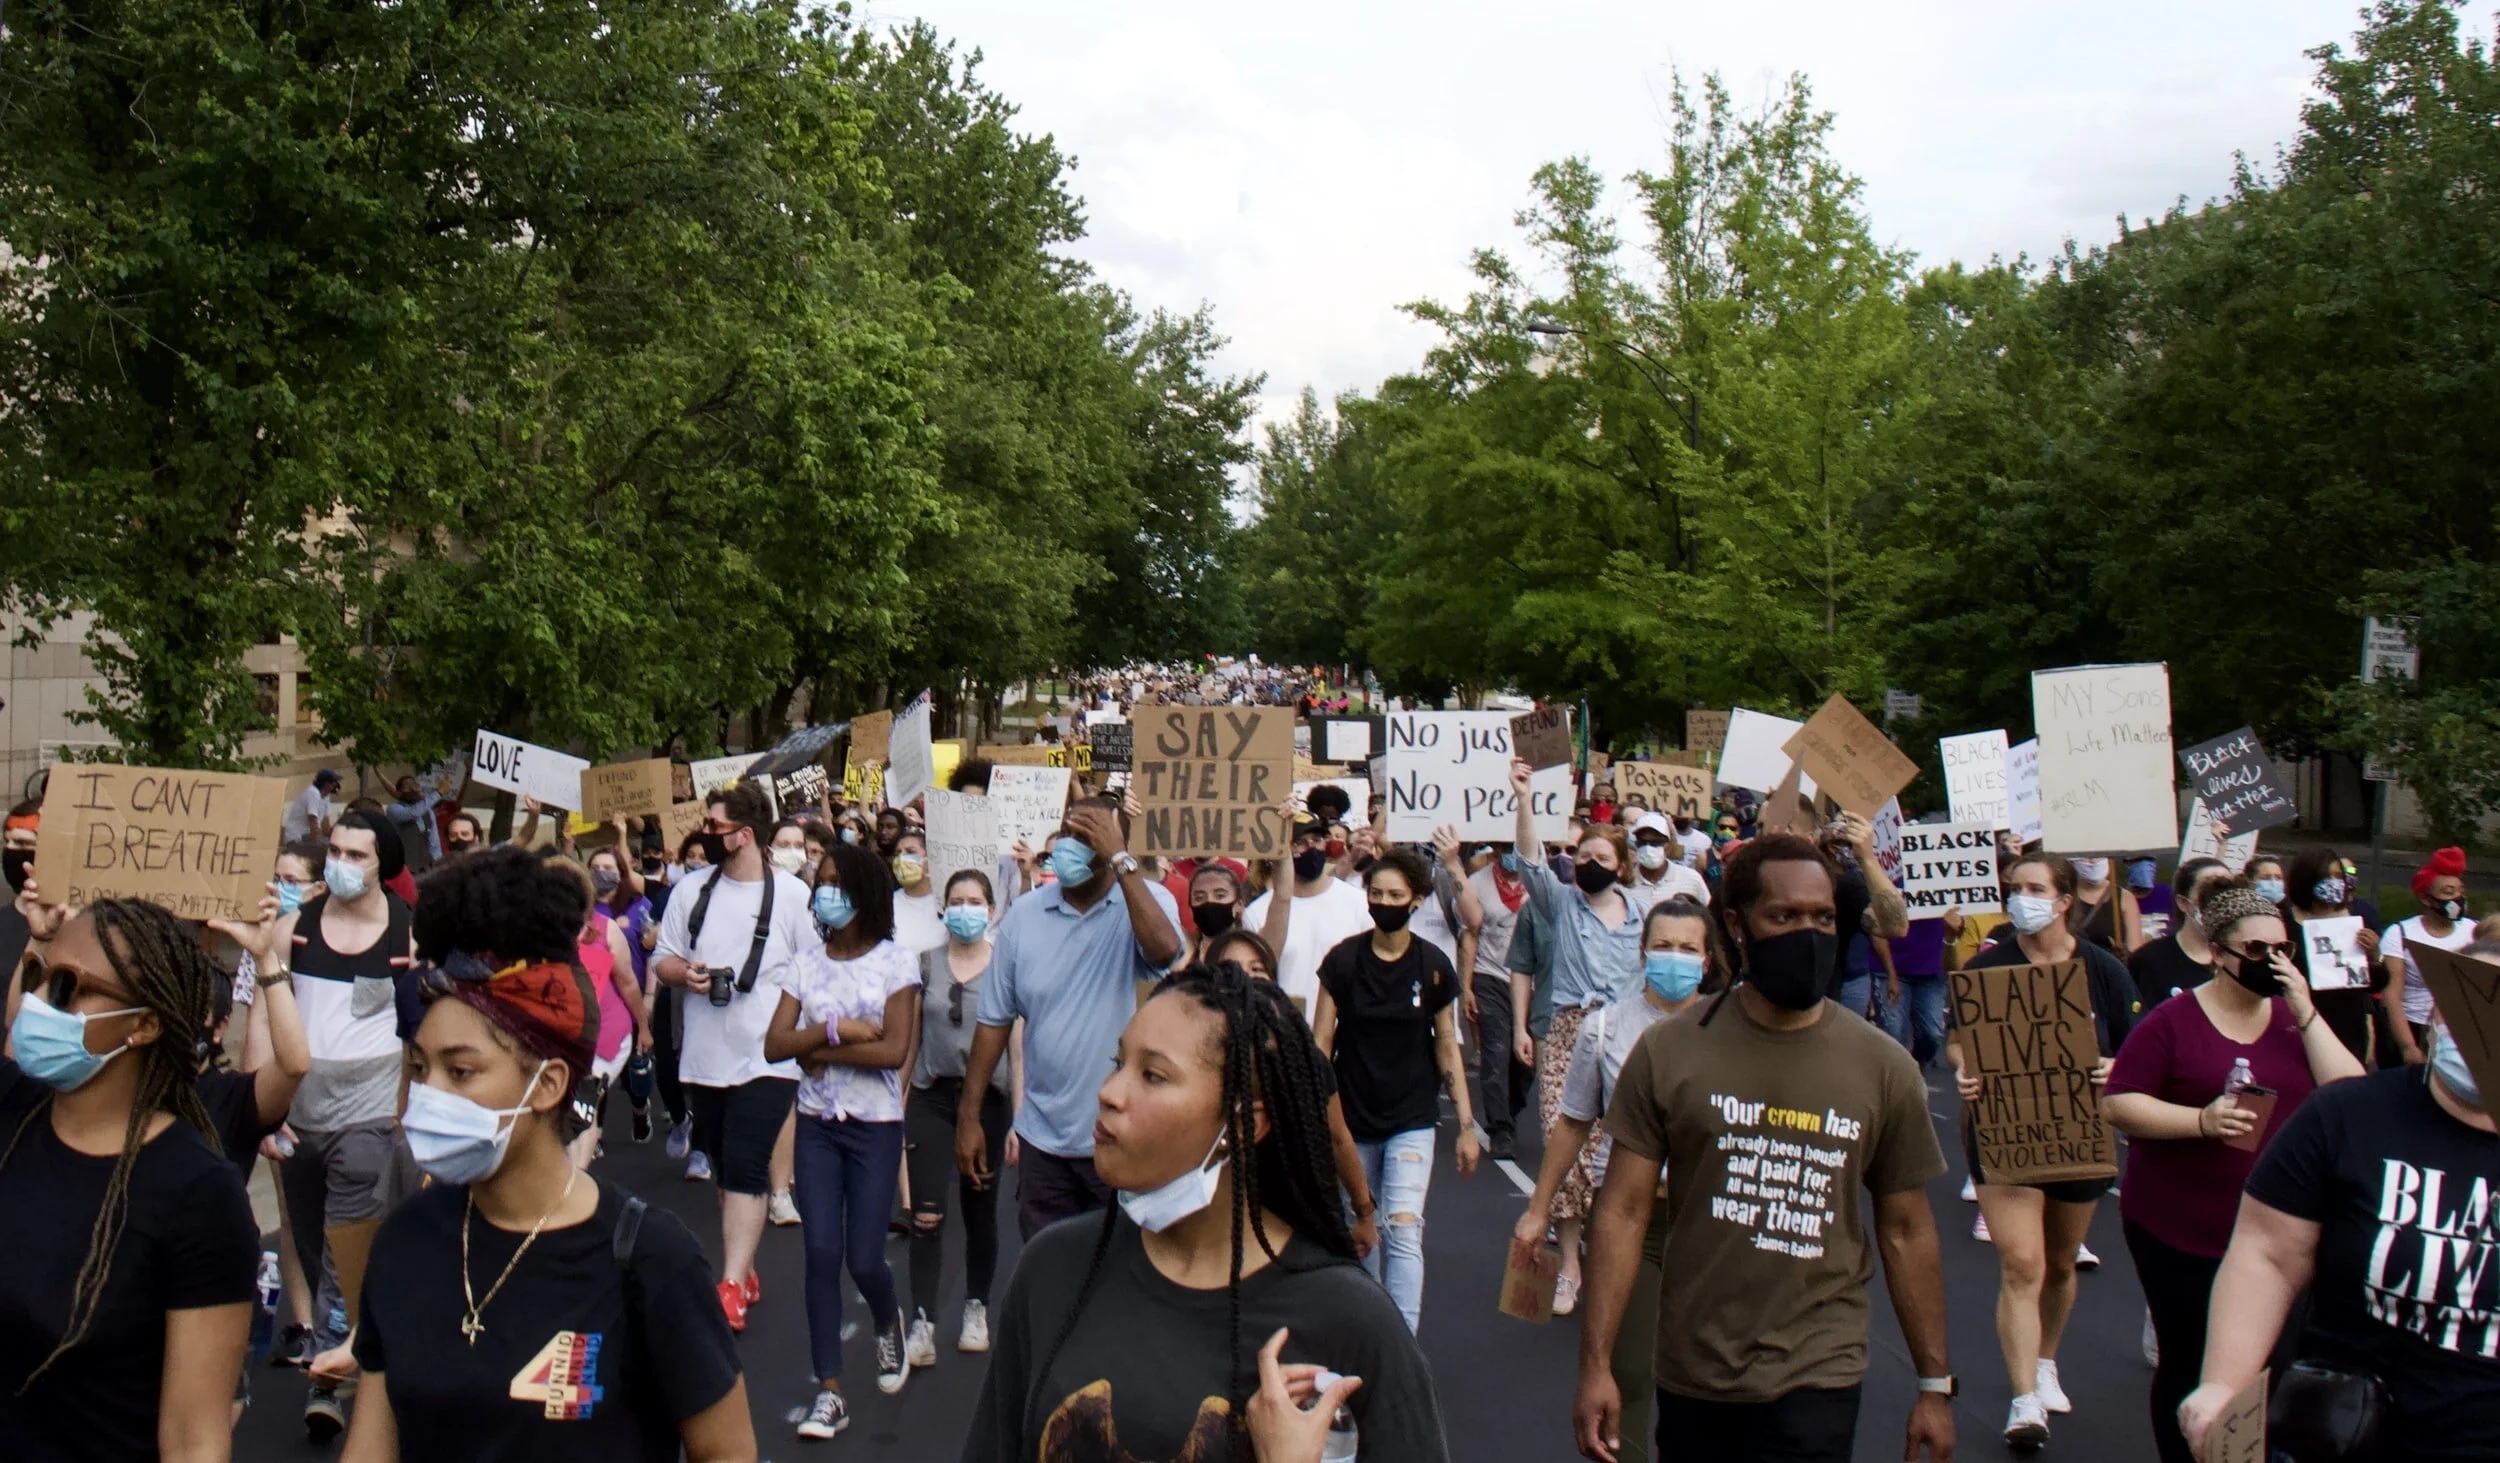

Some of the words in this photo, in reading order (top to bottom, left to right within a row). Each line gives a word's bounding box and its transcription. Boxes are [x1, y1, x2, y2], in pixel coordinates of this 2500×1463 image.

[2053, 680, 2093, 719] MY
[2105, 677, 2164, 714] Sons
[1157, 711, 1262, 761] SAY
[1390, 715, 1439, 748] No
[1511, 708, 1559, 738] DEFUND
[477, 737, 523, 783] LOVE
[1943, 738, 2002, 767] BLACK
[847, 765, 880, 784] LIVS
[1141, 760, 1269, 803] THEIR
[1390, 770, 1441, 812] No
[1623, 763, 1705, 793] Paisa's
[1954, 770, 2007, 794] LIVES
[73, 773, 114, 811] I
[131, 776, 226, 819] CANT
[1953, 799, 2008, 824] MATTE
[83, 823, 257, 875] BREATHE
[1901, 830, 1994, 852] BLACK
[2192, 837, 2248, 861] LIES
[1905, 860, 1990, 880] LIVES
[180, 892, 244, 919] MATTER
[1902, 886, 2000, 908] MATTER
[1952, 963, 2087, 1027] BLACK
[1972, 1021, 2075, 1074] LIVES
[1970, 1067, 2102, 1125] MATTER!
[1767, 1107, 1821, 1132] crown
[1825, 1108, 1861, 1141] has
[1980, 1121, 2066, 1147] SILENCE
[2080, 1119, 2104, 1140] IS
[1718, 1132, 1769, 1156] already
[1770, 1138, 1802, 1157] been
[1805, 1144, 1847, 1168] bought
[1984, 1141, 2106, 1169] VIOLENCE
[1728, 1154, 1758, 1177] and
[1761, 1159, 1799, 1184] paid
[1802, 1166, 1832, 1193] for.
[1727, 1177, 1742, 1194] All
[1743, 1181, 1758, 1195] we
[1759, 1184, 1785, 1200] have
[1787, 1186, 1799, 1203] to
[1800, 1191, 1814, 1206] do
[1815, 1193, 1826, 1209] is
[2377, 1157, 2496, 1243] BLA
[1712, 1196, 1761, 1227] wear
[2364, 1223, 2500, 1311] LIV
[2364, 1286, 2500, 1358] MATT
[509, 1330, 588, 1419] 4
[546, 1335, 572, 1417] HUNNID
